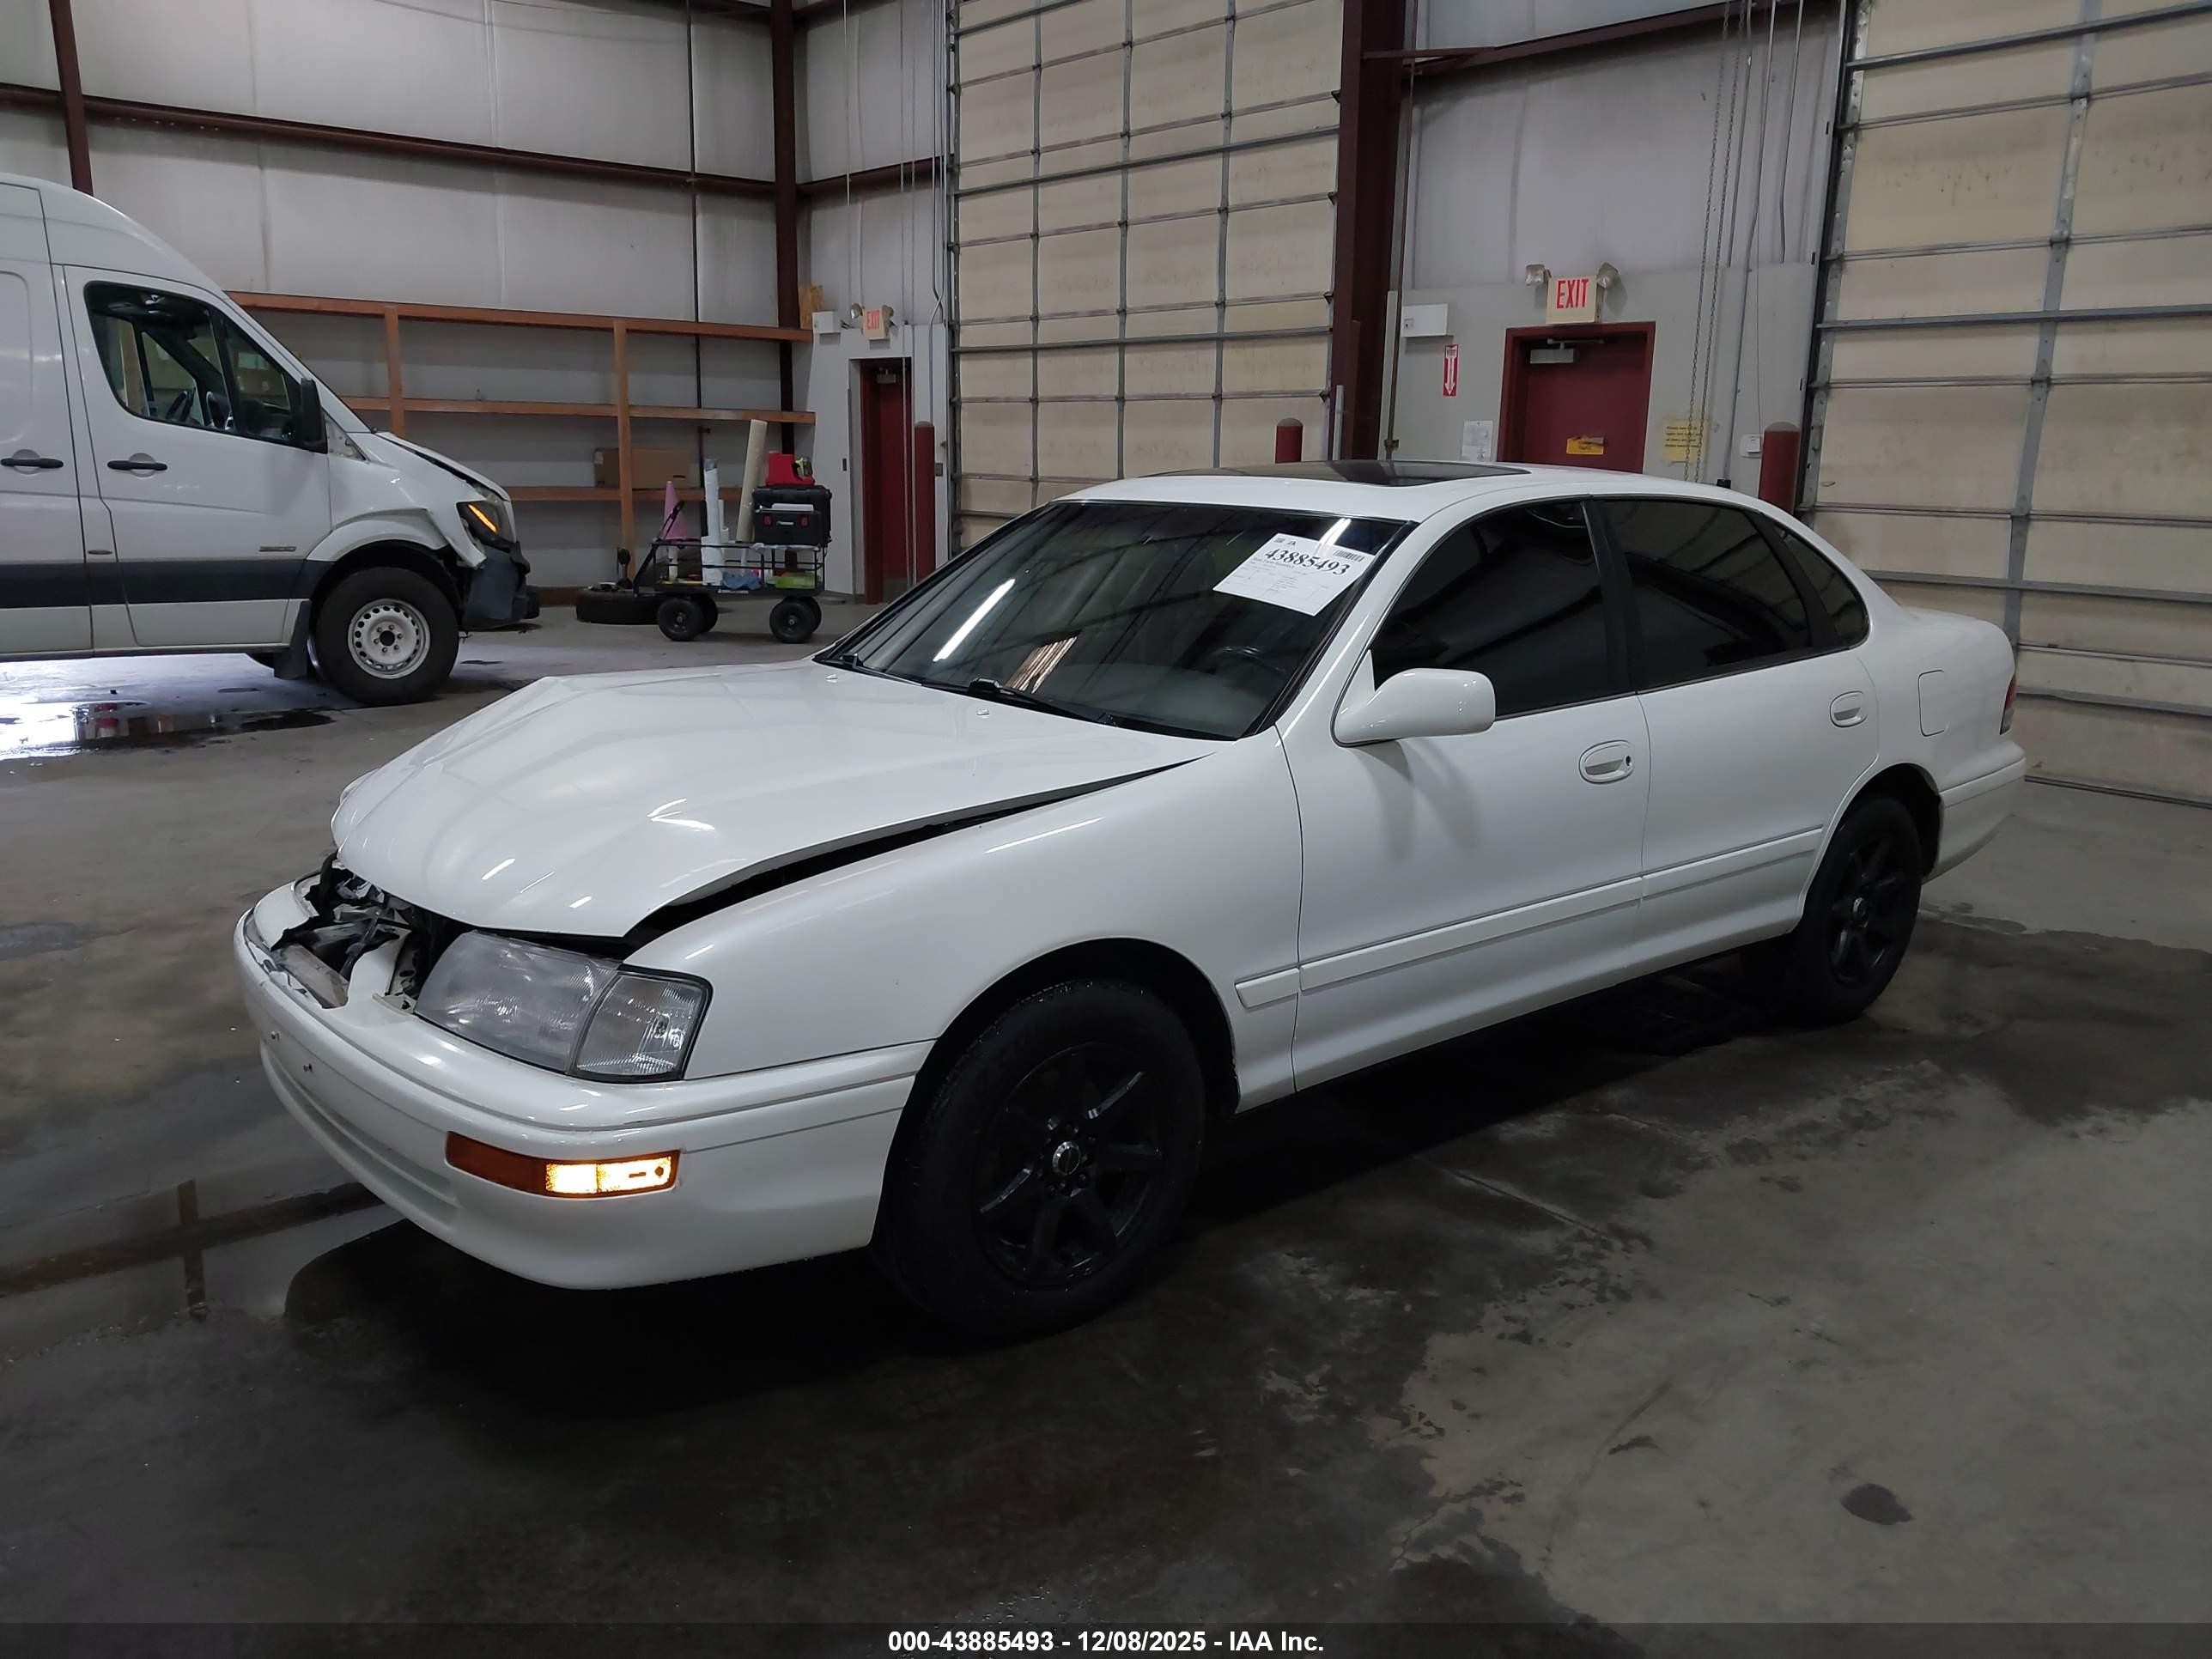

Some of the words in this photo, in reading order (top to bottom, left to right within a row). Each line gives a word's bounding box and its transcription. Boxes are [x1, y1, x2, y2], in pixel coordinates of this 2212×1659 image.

[1556, 278, 1589, 309] EXIT
[866, 309, 880, 330] EXIT
[1265, 548, 1351, 575] 43885493
